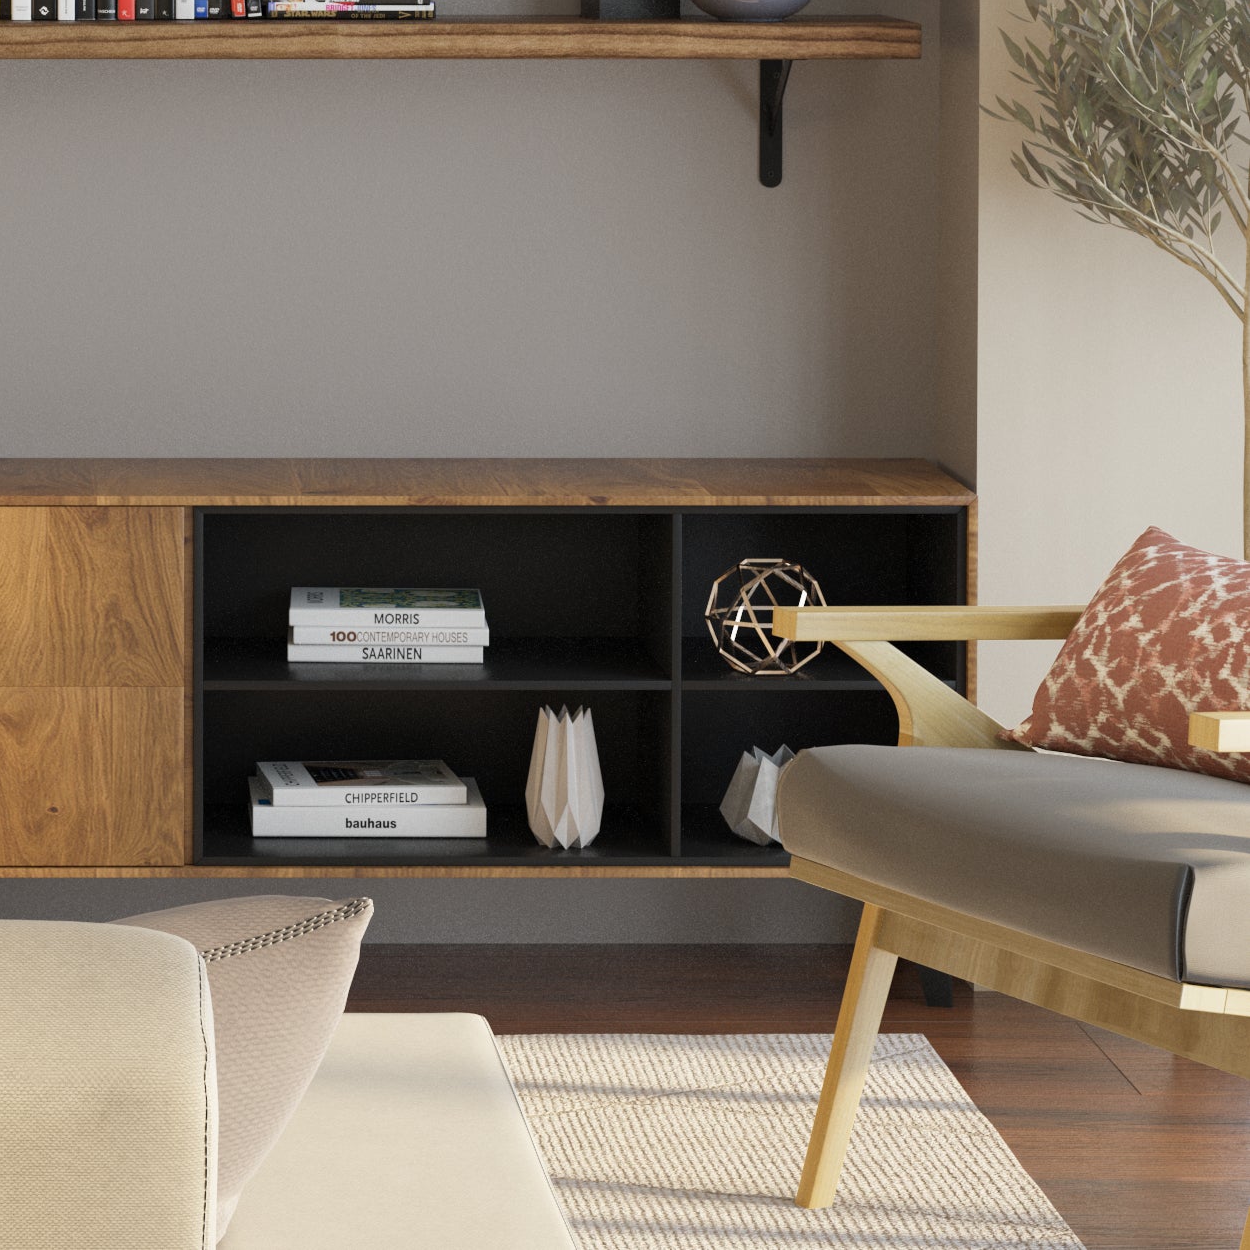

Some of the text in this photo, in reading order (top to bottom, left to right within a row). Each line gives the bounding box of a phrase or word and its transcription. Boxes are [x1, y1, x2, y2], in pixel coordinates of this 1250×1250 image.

[374, 613, 420, 624] MORRIS
[432, 632, 468, 643] HOUSES
[362, 647, 422, 660] SAARINEN
[345, 792, 419, 804] CHIPPERFIELD
[345, 818, 397, 829] bauhaus
